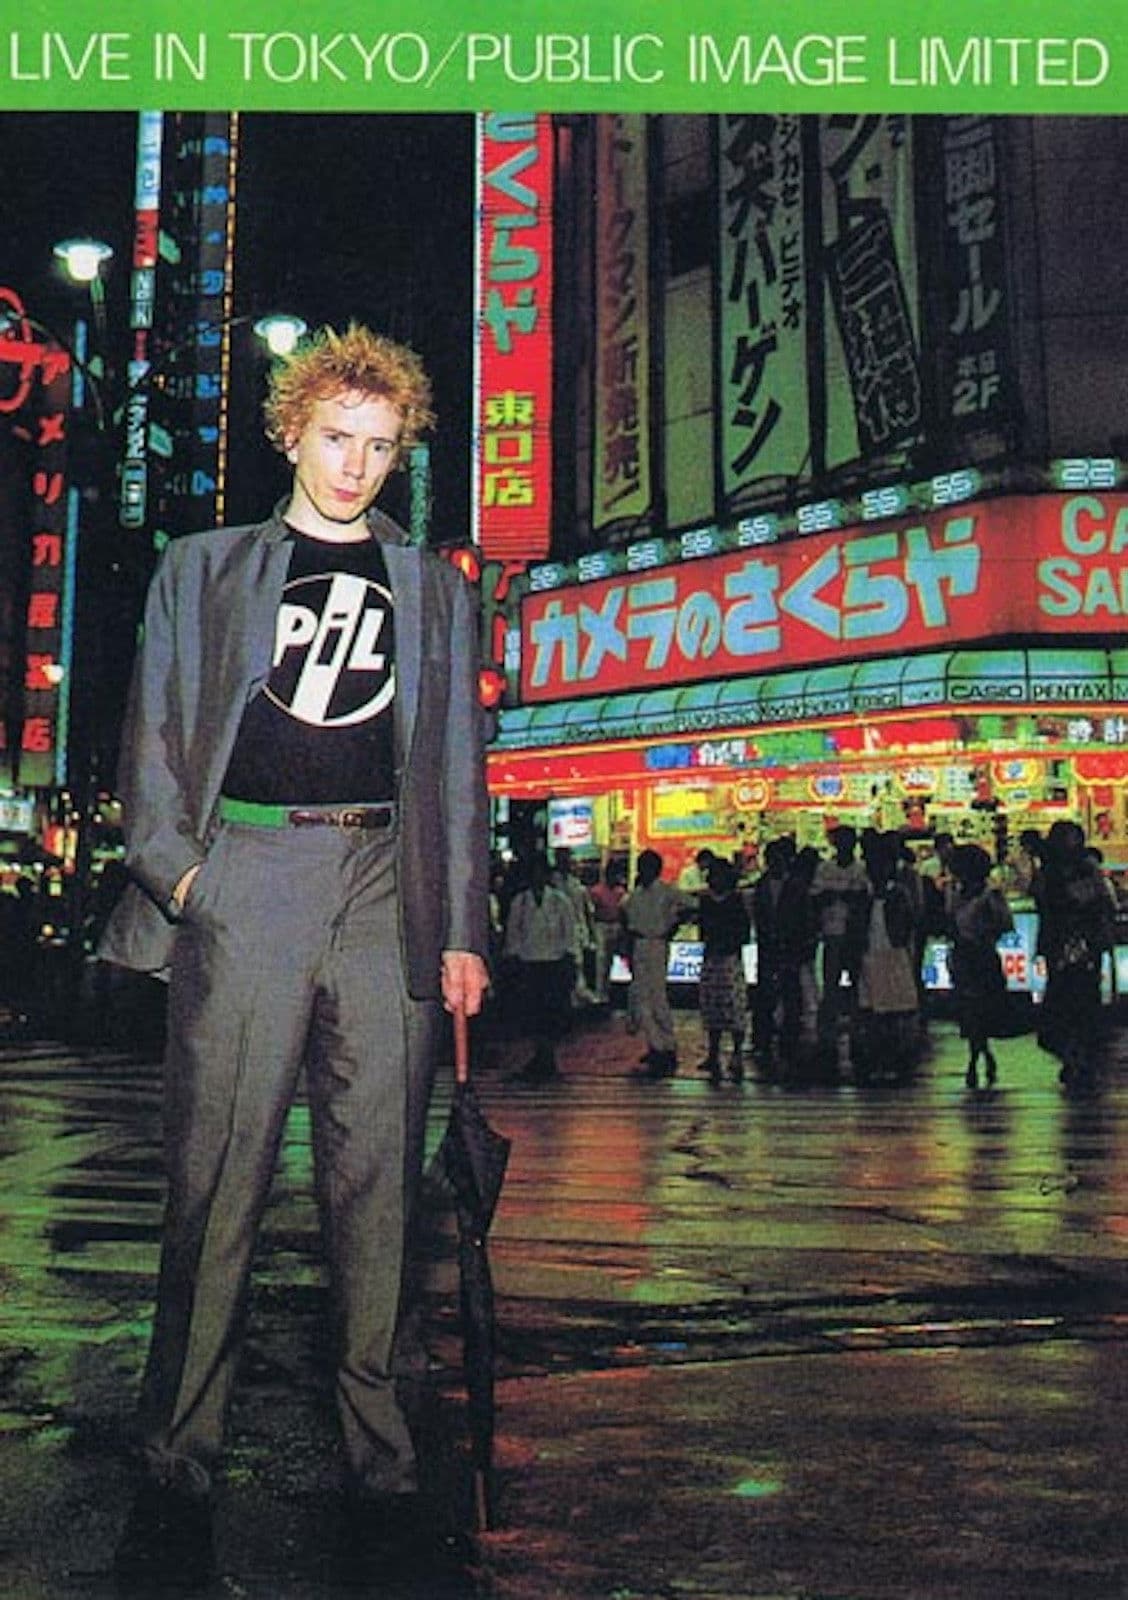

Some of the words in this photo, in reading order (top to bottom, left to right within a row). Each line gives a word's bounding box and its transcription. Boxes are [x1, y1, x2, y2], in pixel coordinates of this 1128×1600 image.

[952, 375, 1000, 416] 2F
[483, 391, 535, 508] 東口店
[529, 517, 982, 688] カメラのさくらや
[951, 684, 1024, 699] CASIO
[1033, 681, 1107, 699] PENTAX
